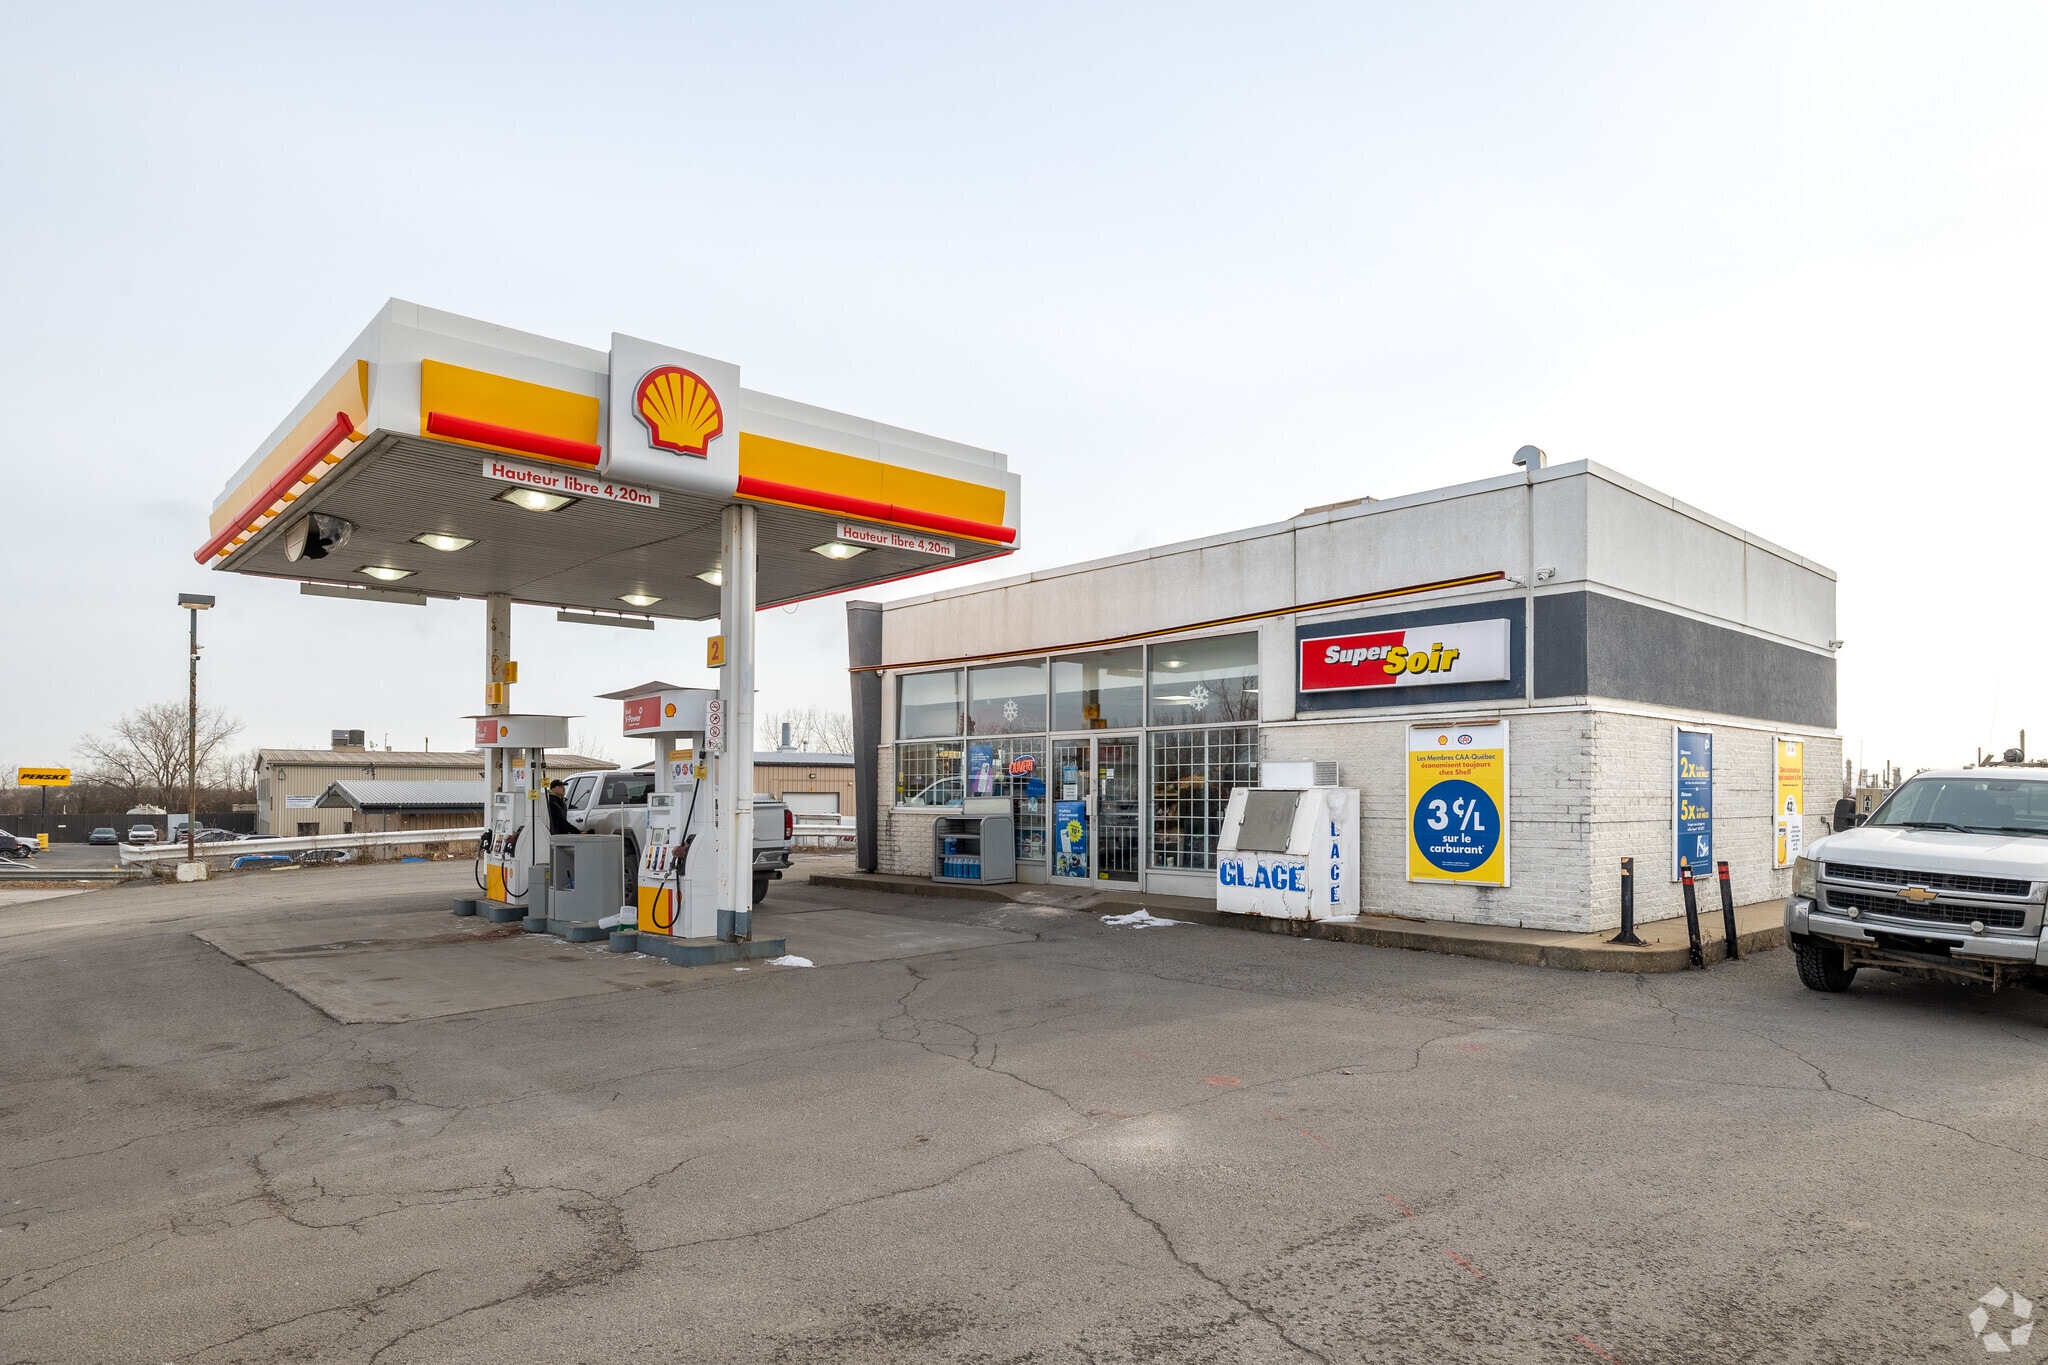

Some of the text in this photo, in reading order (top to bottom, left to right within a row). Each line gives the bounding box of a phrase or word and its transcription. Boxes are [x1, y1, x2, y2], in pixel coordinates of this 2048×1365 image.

[492, 463, 652, 504] Hauteur libre 4,20m
[843, 526, 950, 555] Hauteur libre 4,20m
[711, 641, 719, 661] 2
[1324, 642, 1460, 676] Super Soir
[488, 686, 493, 700] 4
[1009, 759, 1034, 774] OUVERT
[1455, 753, 1496, 761] CAA-Québec
[1463, 761, 1491, 769] toujours
[1680, 756, 1696, 778] 2x
[1681, 799, 1696, 820] 5x
[1442, 833, 1471, 843] sur le
[1330, 821, 1340, 903] LACE
[1220, 858, 1305, 892] GLACE
